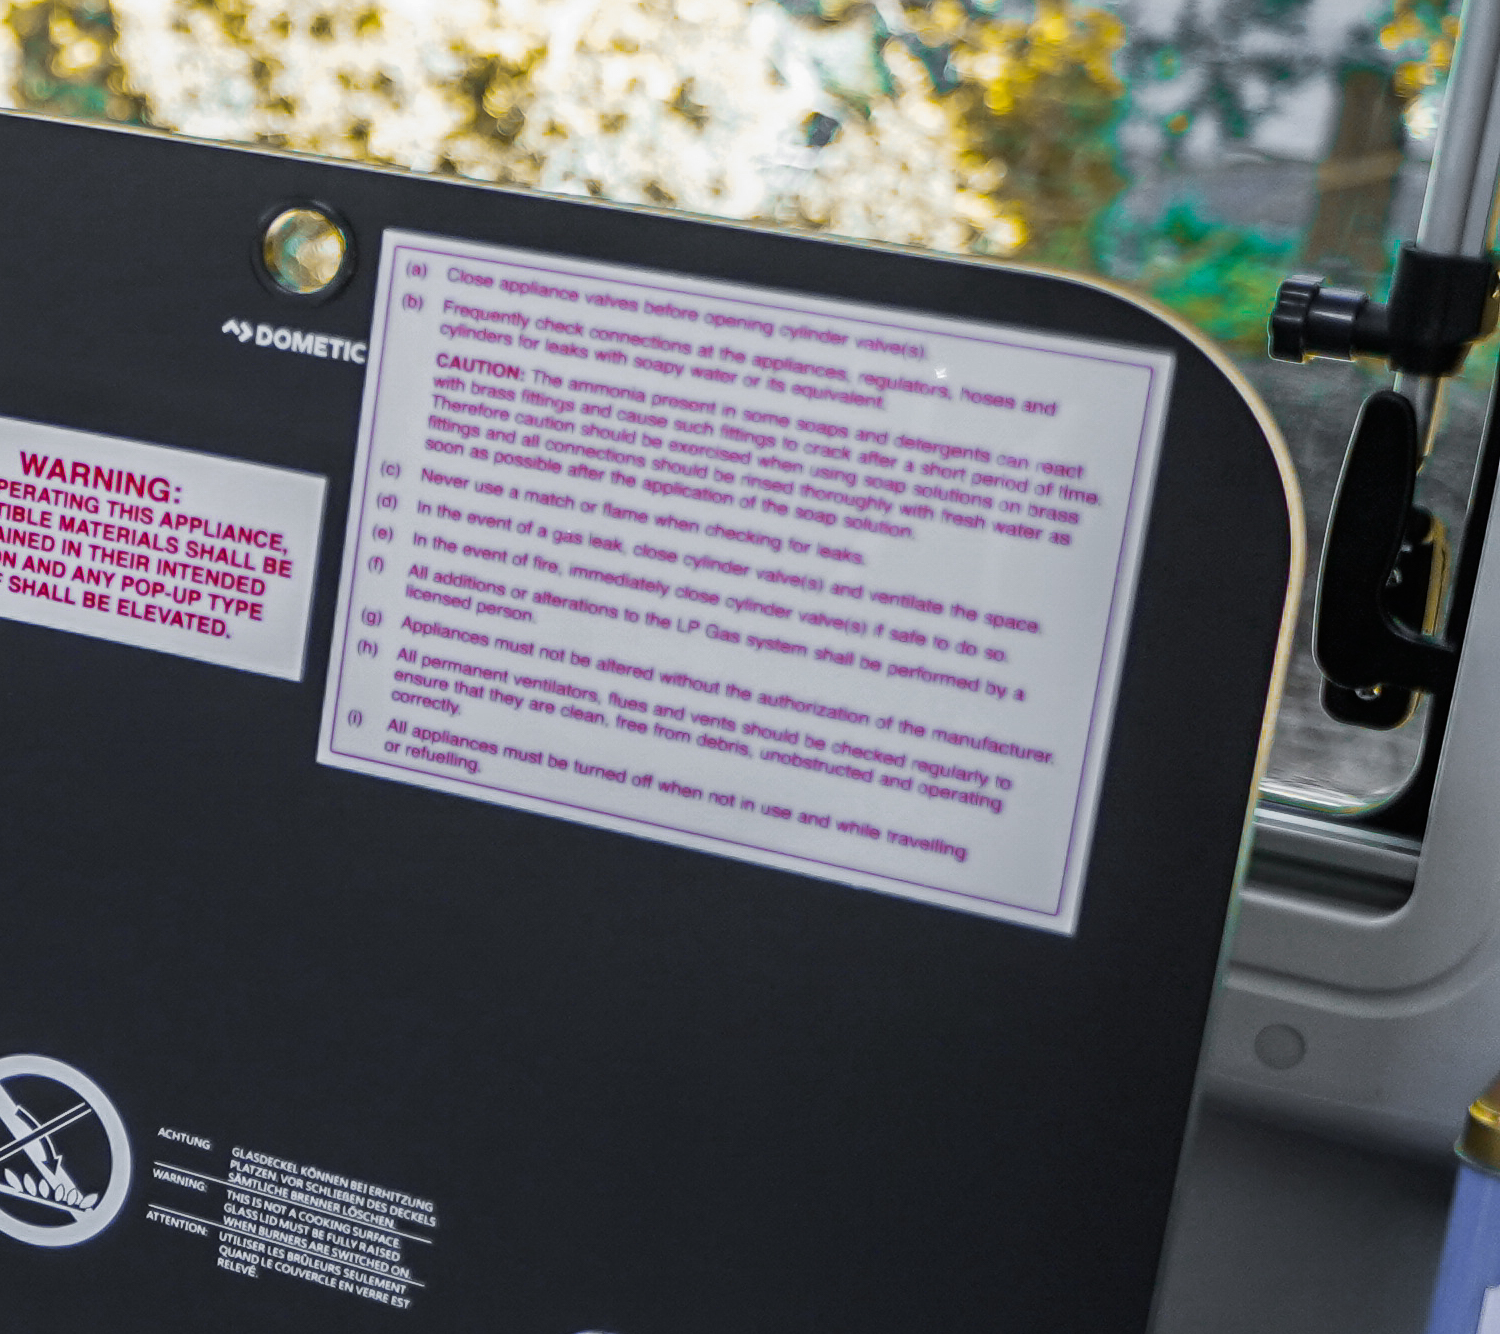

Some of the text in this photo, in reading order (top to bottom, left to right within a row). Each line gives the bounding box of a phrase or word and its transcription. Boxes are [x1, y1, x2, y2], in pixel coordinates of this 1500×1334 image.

[255, 327, 367, 364] DOMETIC
[19, 450, 183, 505] WARNING:
[379, 460, 402, 479] (c)
[421, 466, 471, 490] Never
[474, 481, 505, 497] use
[508, 487, 521, 500] a
[523, 490, 576, 510] match
[579, 500, 599, 513] or
[602, 501, 650, 524] flame
[653, 514, 701, 533] when
[704, 523, 784, 552] checking
[787, 537, 812, 554] for
[58, 514, 179, 555] MATERIALS
[185, 539, 257, 572] SHALL
[262, 555, 293, 579] BE
[106, 499, 155, 526] THIS
[159, 511, 289, 556] APPLIANCE,
[21, 554, 67, 579] AND
[70, 565, 117, 589] ANY
[120, 574, 203, 606] POP-UP
[207, 593, 264, 622] TYPE
[61, 538, 83, 559] IN
[87, 543, 151, 573] THEIR
[156, 558, 267, 597] INTENDED
[7, 574, 77, 606] SHALL
[81, 590, 111, 613] BE
[116, 597, 231, 639] ELEVATED.
[226, 1189, 251, 1206] THIS
[251, 1196, 263, 1209] IS
[263, 1200, 288, 1216] NOT
[287, 1207, 297, 1220] A
[298, 1210, 352, 1235] COOKING
